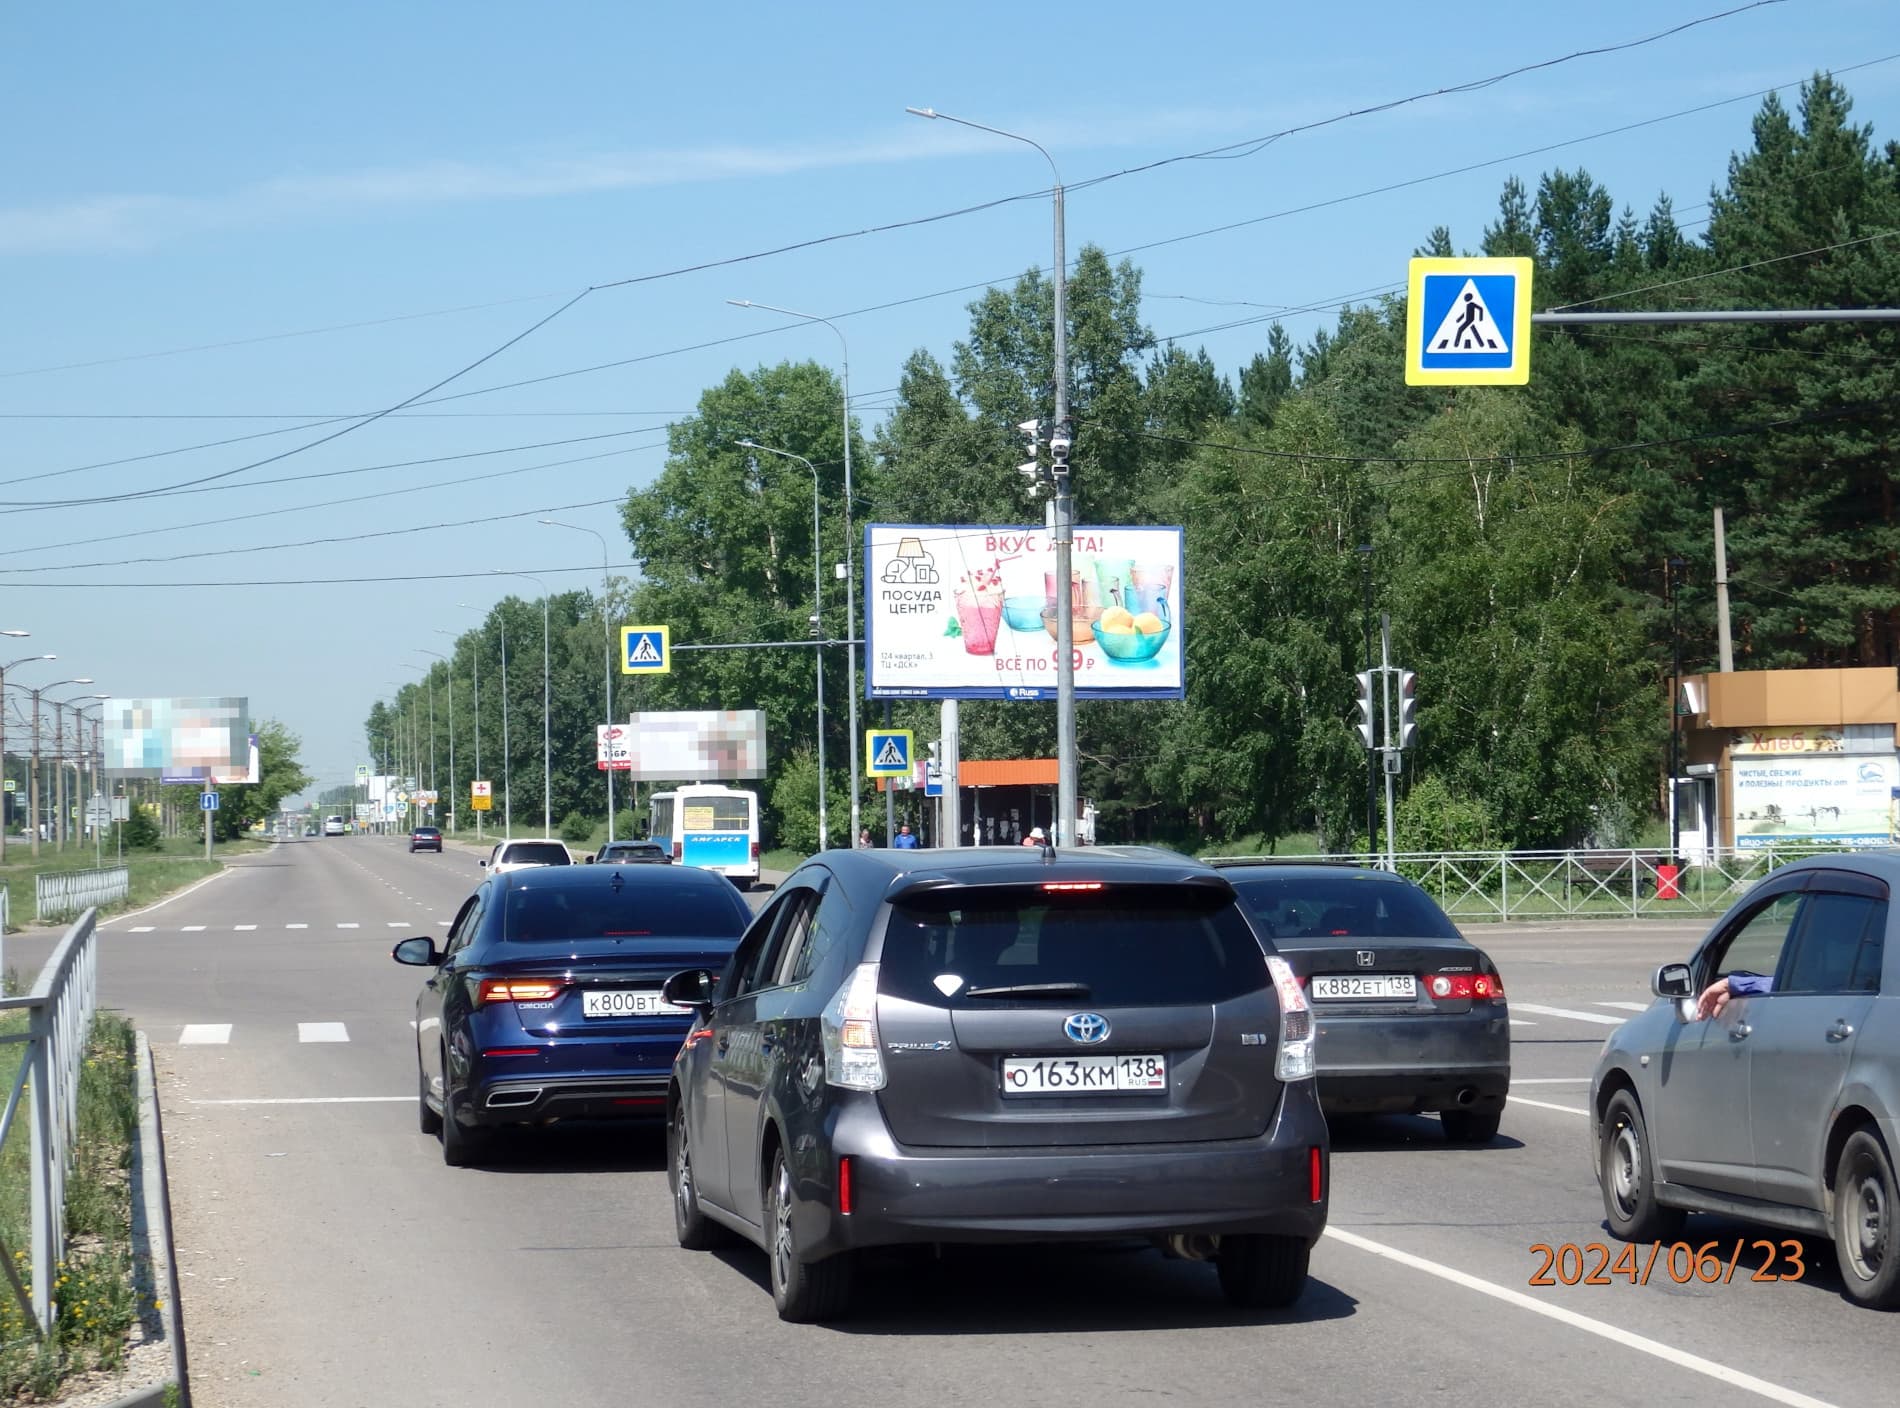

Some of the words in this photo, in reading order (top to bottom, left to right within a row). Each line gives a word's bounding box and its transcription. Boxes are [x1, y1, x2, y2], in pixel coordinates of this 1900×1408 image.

[985, 536, 1036, 552] ВКУС
[882, 590, 942, 601] ПОСУДА
[889, 603, 936, 615] ЦЕНТР
[995, 655, 1022, 671] ВСЁ
[1026, 658, 1047, 671] ПО
[1751, 732, 1806, 752] Хлеб
[1318, 978, 1382, 995] К882ЕТ
[1387, 976, 1411, 989] 138
[590, 993, 657, 1011] К800ВТ
[1012, 1059, 1116, 1088] О163КМ
[1121, 1057, 1159, 1078] 138
